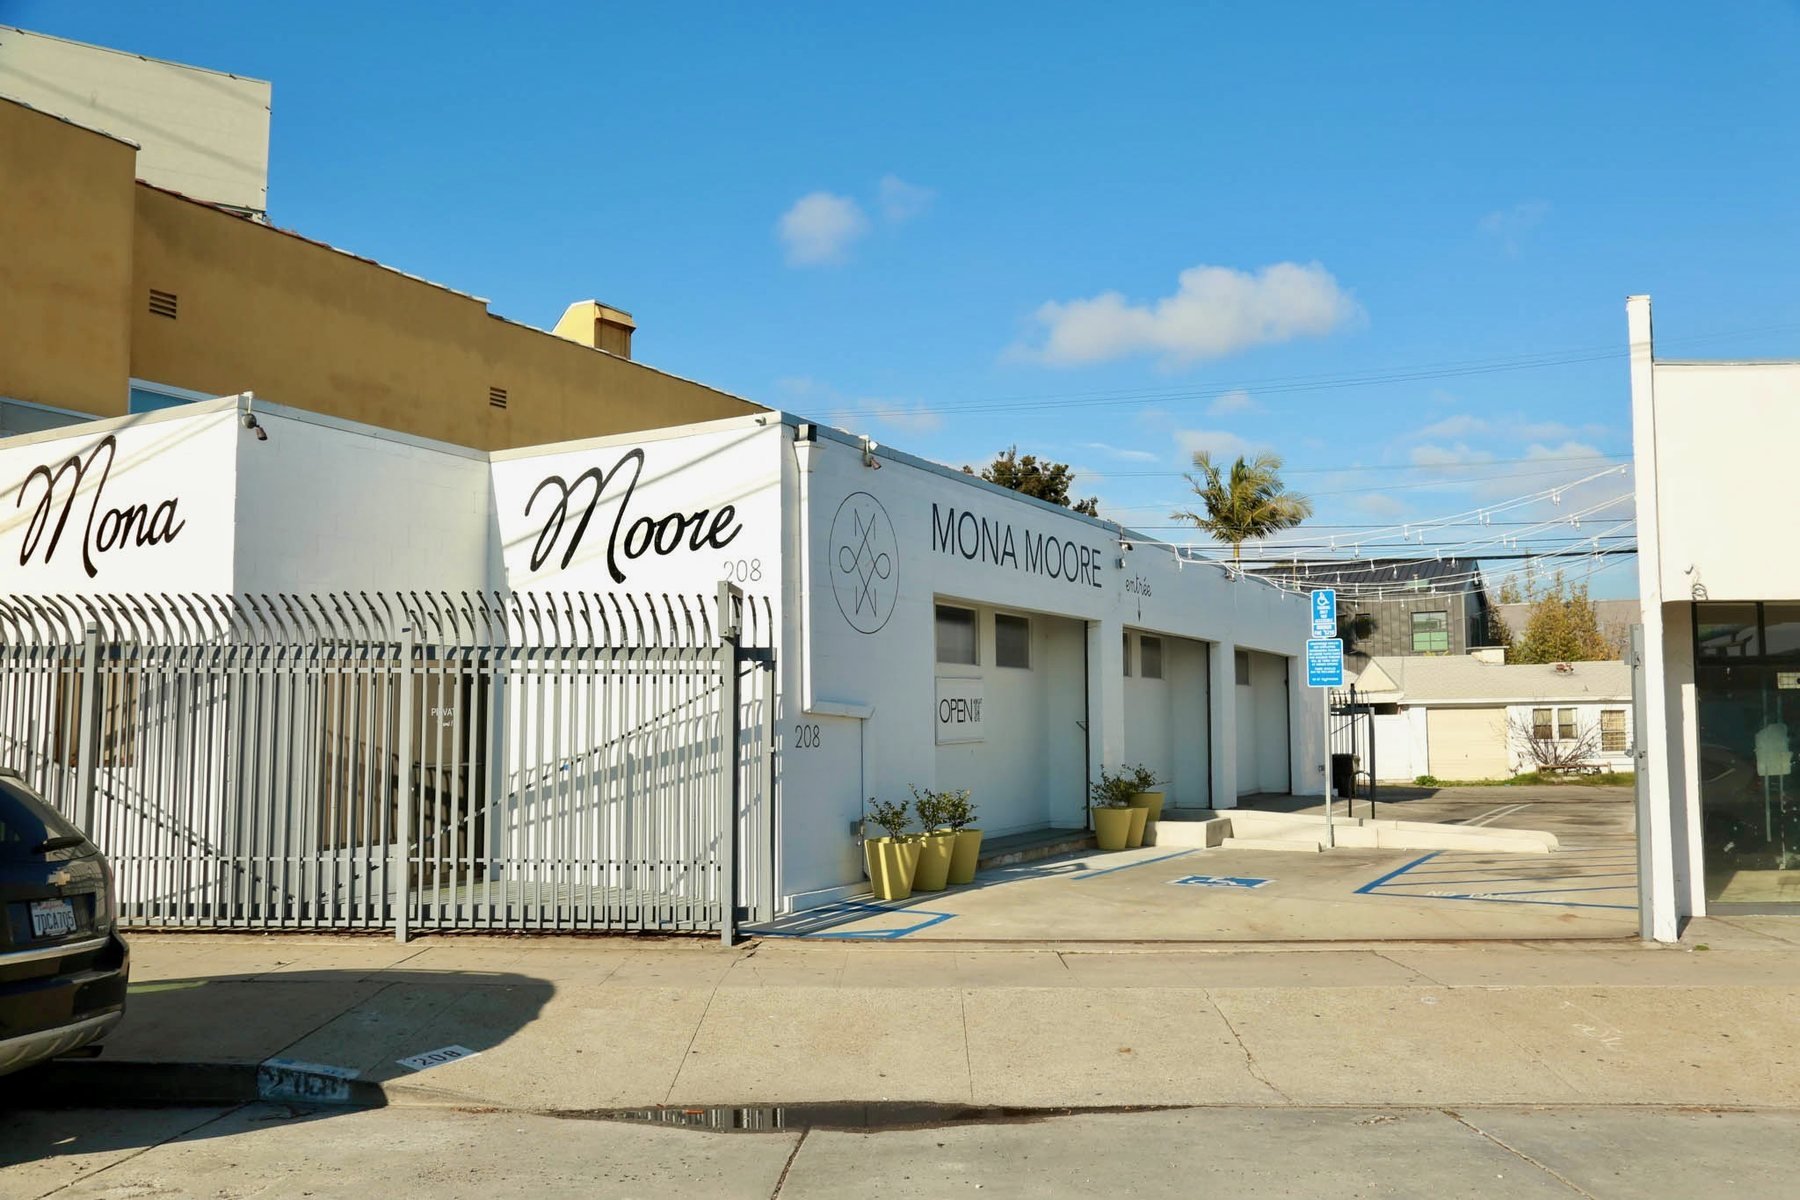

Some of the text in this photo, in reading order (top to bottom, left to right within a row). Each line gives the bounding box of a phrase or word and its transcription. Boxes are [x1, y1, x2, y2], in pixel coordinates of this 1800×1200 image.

[17, 434, 186, 579] Mona
[524, 447, 743, 584] Moore
[932, 502, 1102, 588] MONA MOORE
[723, 558, 762, 582] 208
[1125, 572, 1152, 598] entrée
[939, 698, 973, 723] OPEN
[795, 724, 821, 749] 208
[34, 910, 75, 931] 7DCA705
[411, 1050, 462, 1067] 208
